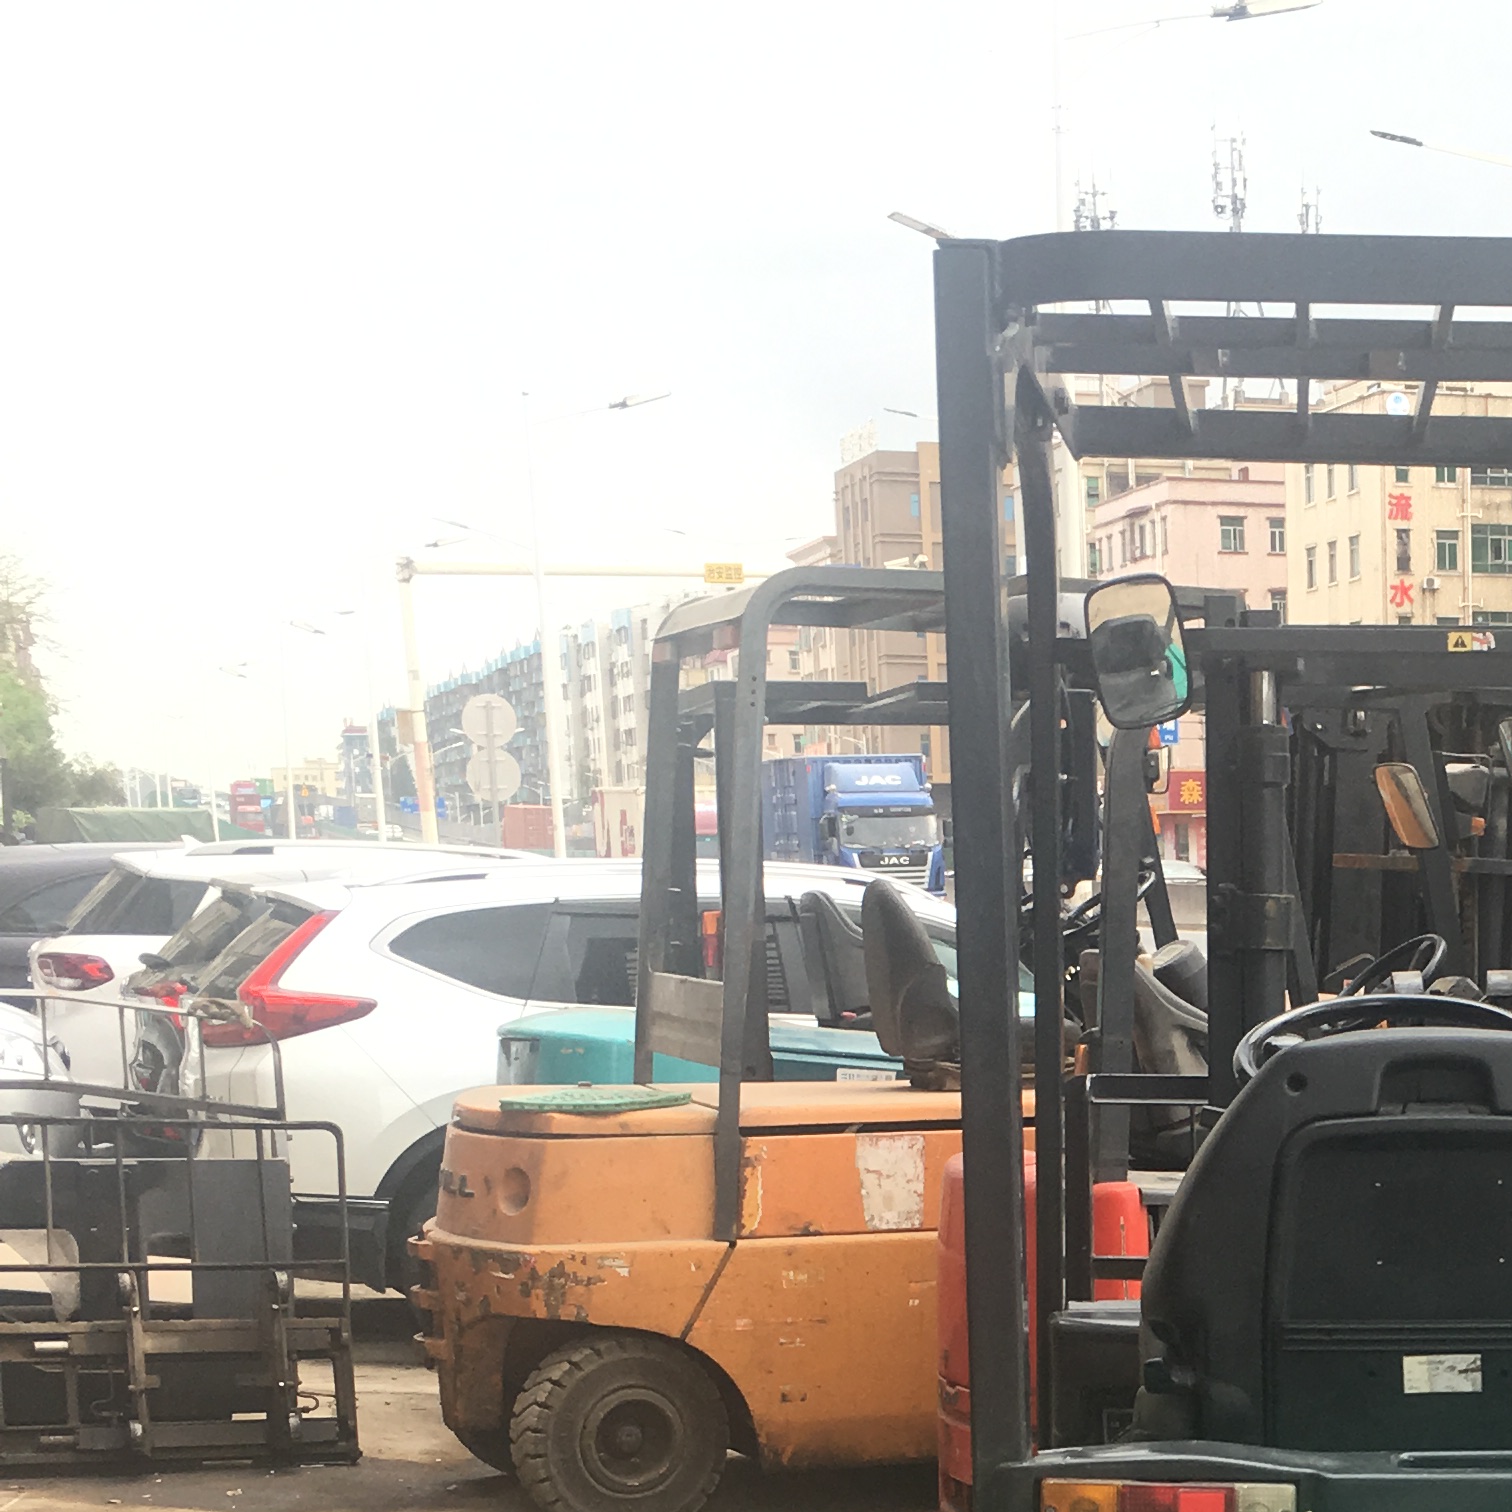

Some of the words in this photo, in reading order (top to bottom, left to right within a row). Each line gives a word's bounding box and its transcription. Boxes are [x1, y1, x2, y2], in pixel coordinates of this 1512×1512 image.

[855, 775, 902, 786] JAC
[1180, 779, 1203, 805] 森
[880, 856, 910, 865] JAC
